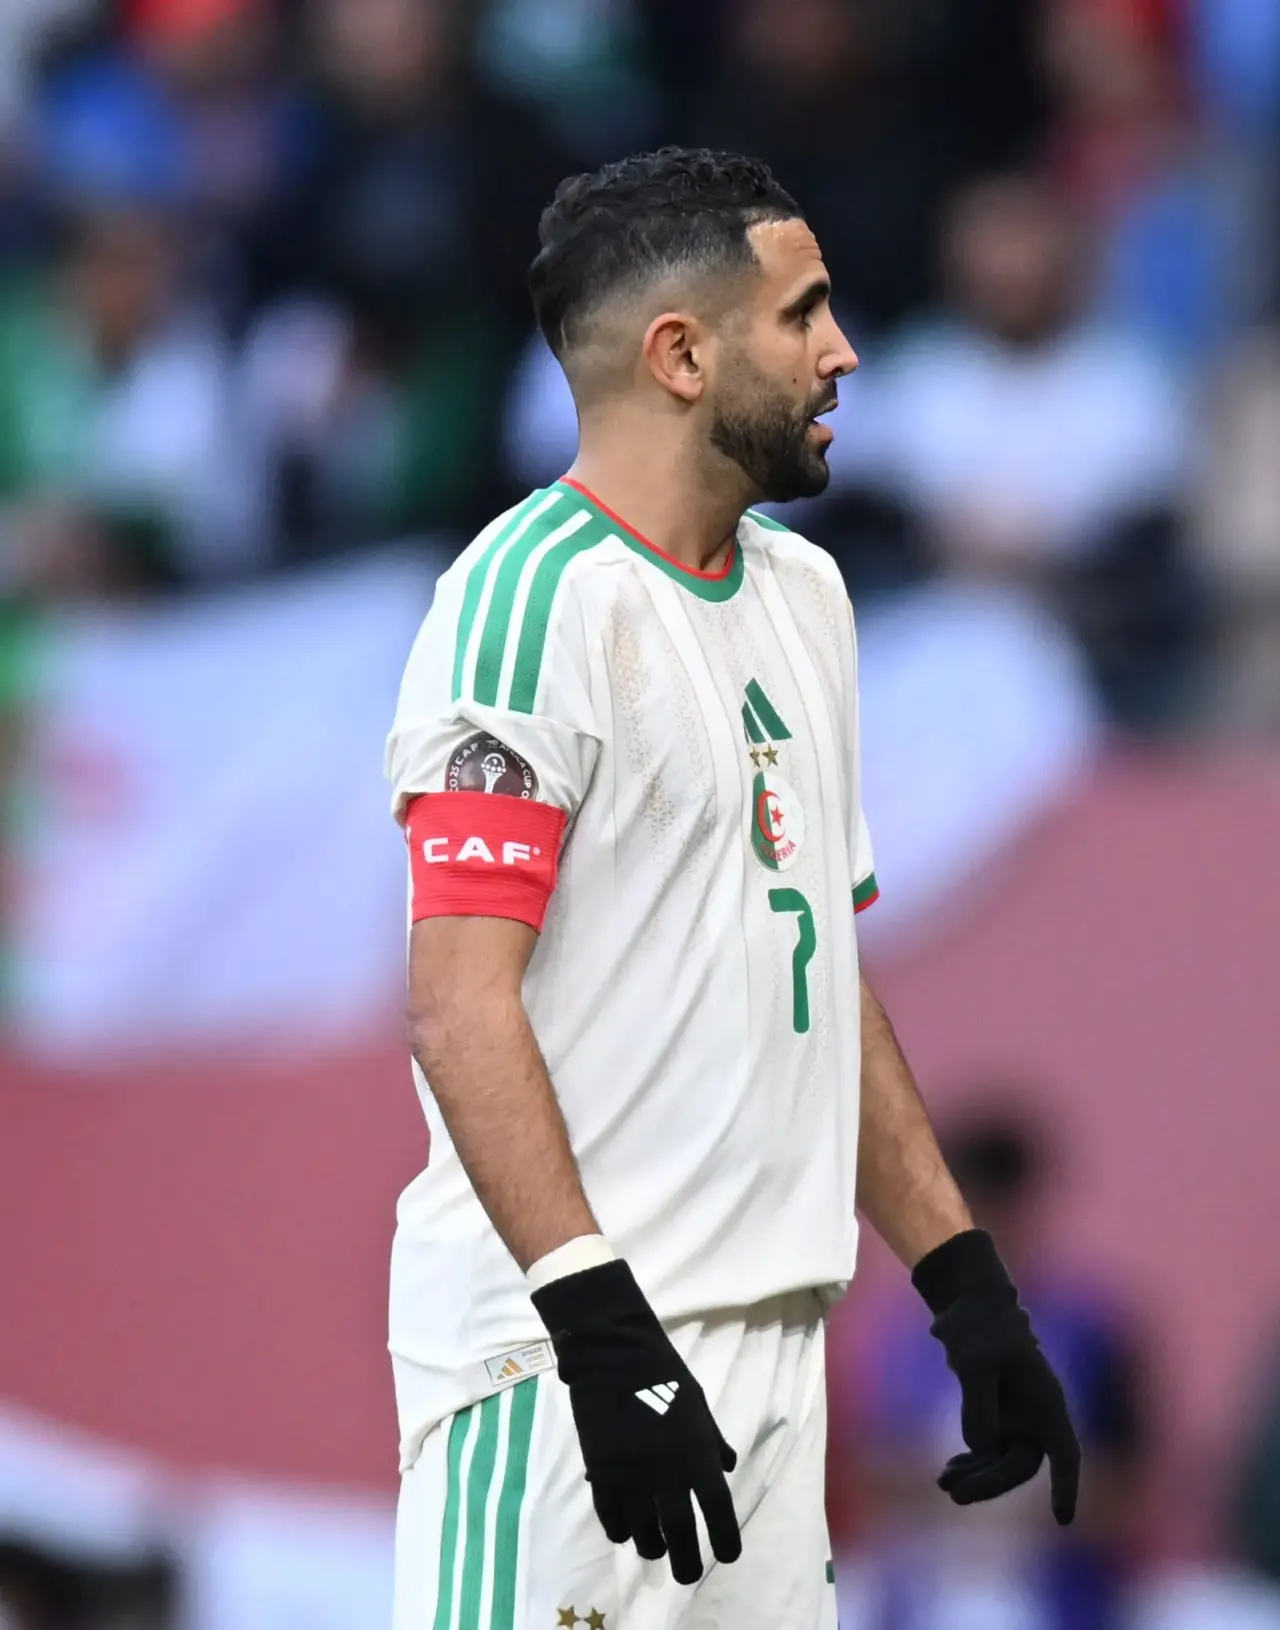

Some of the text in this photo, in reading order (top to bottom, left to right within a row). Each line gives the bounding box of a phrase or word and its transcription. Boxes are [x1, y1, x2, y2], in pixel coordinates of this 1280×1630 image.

[522, 769, 532, 789] CUP
[423, 836, 531, 865] CAF
[761, 840, 797, 862] GERIA
[768, 887, 817, 1034] 7
